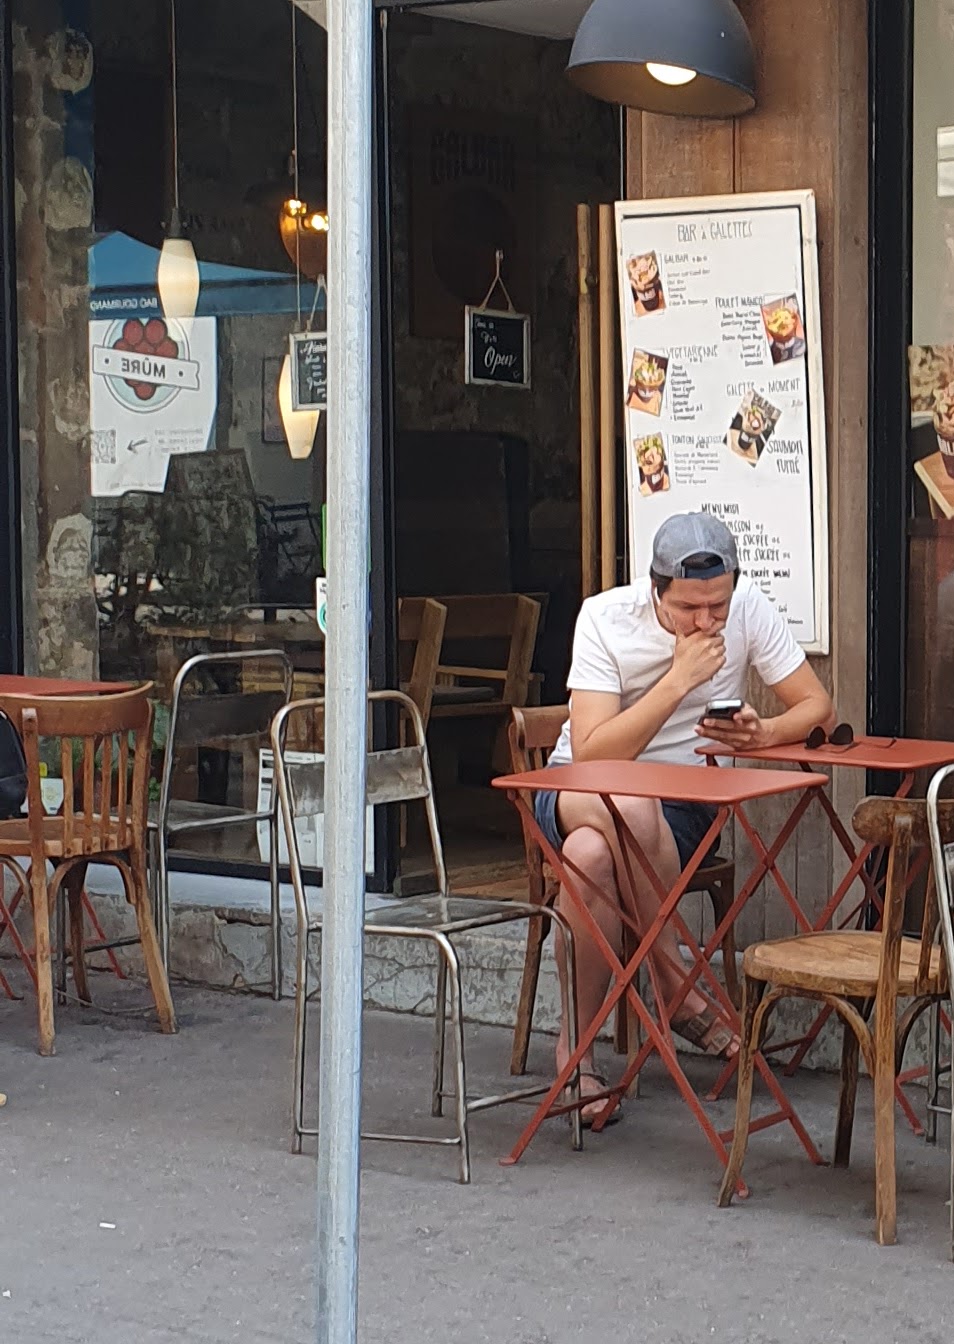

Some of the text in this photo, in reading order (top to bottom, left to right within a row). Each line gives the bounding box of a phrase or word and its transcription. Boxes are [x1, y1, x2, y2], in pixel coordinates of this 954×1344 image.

[677, 223, 697, 243] BAR
[710, 221, 753, 241] GALETTES
[484, 345, 518, 376] Open
[766, 439, 804, 455] SAUMON
